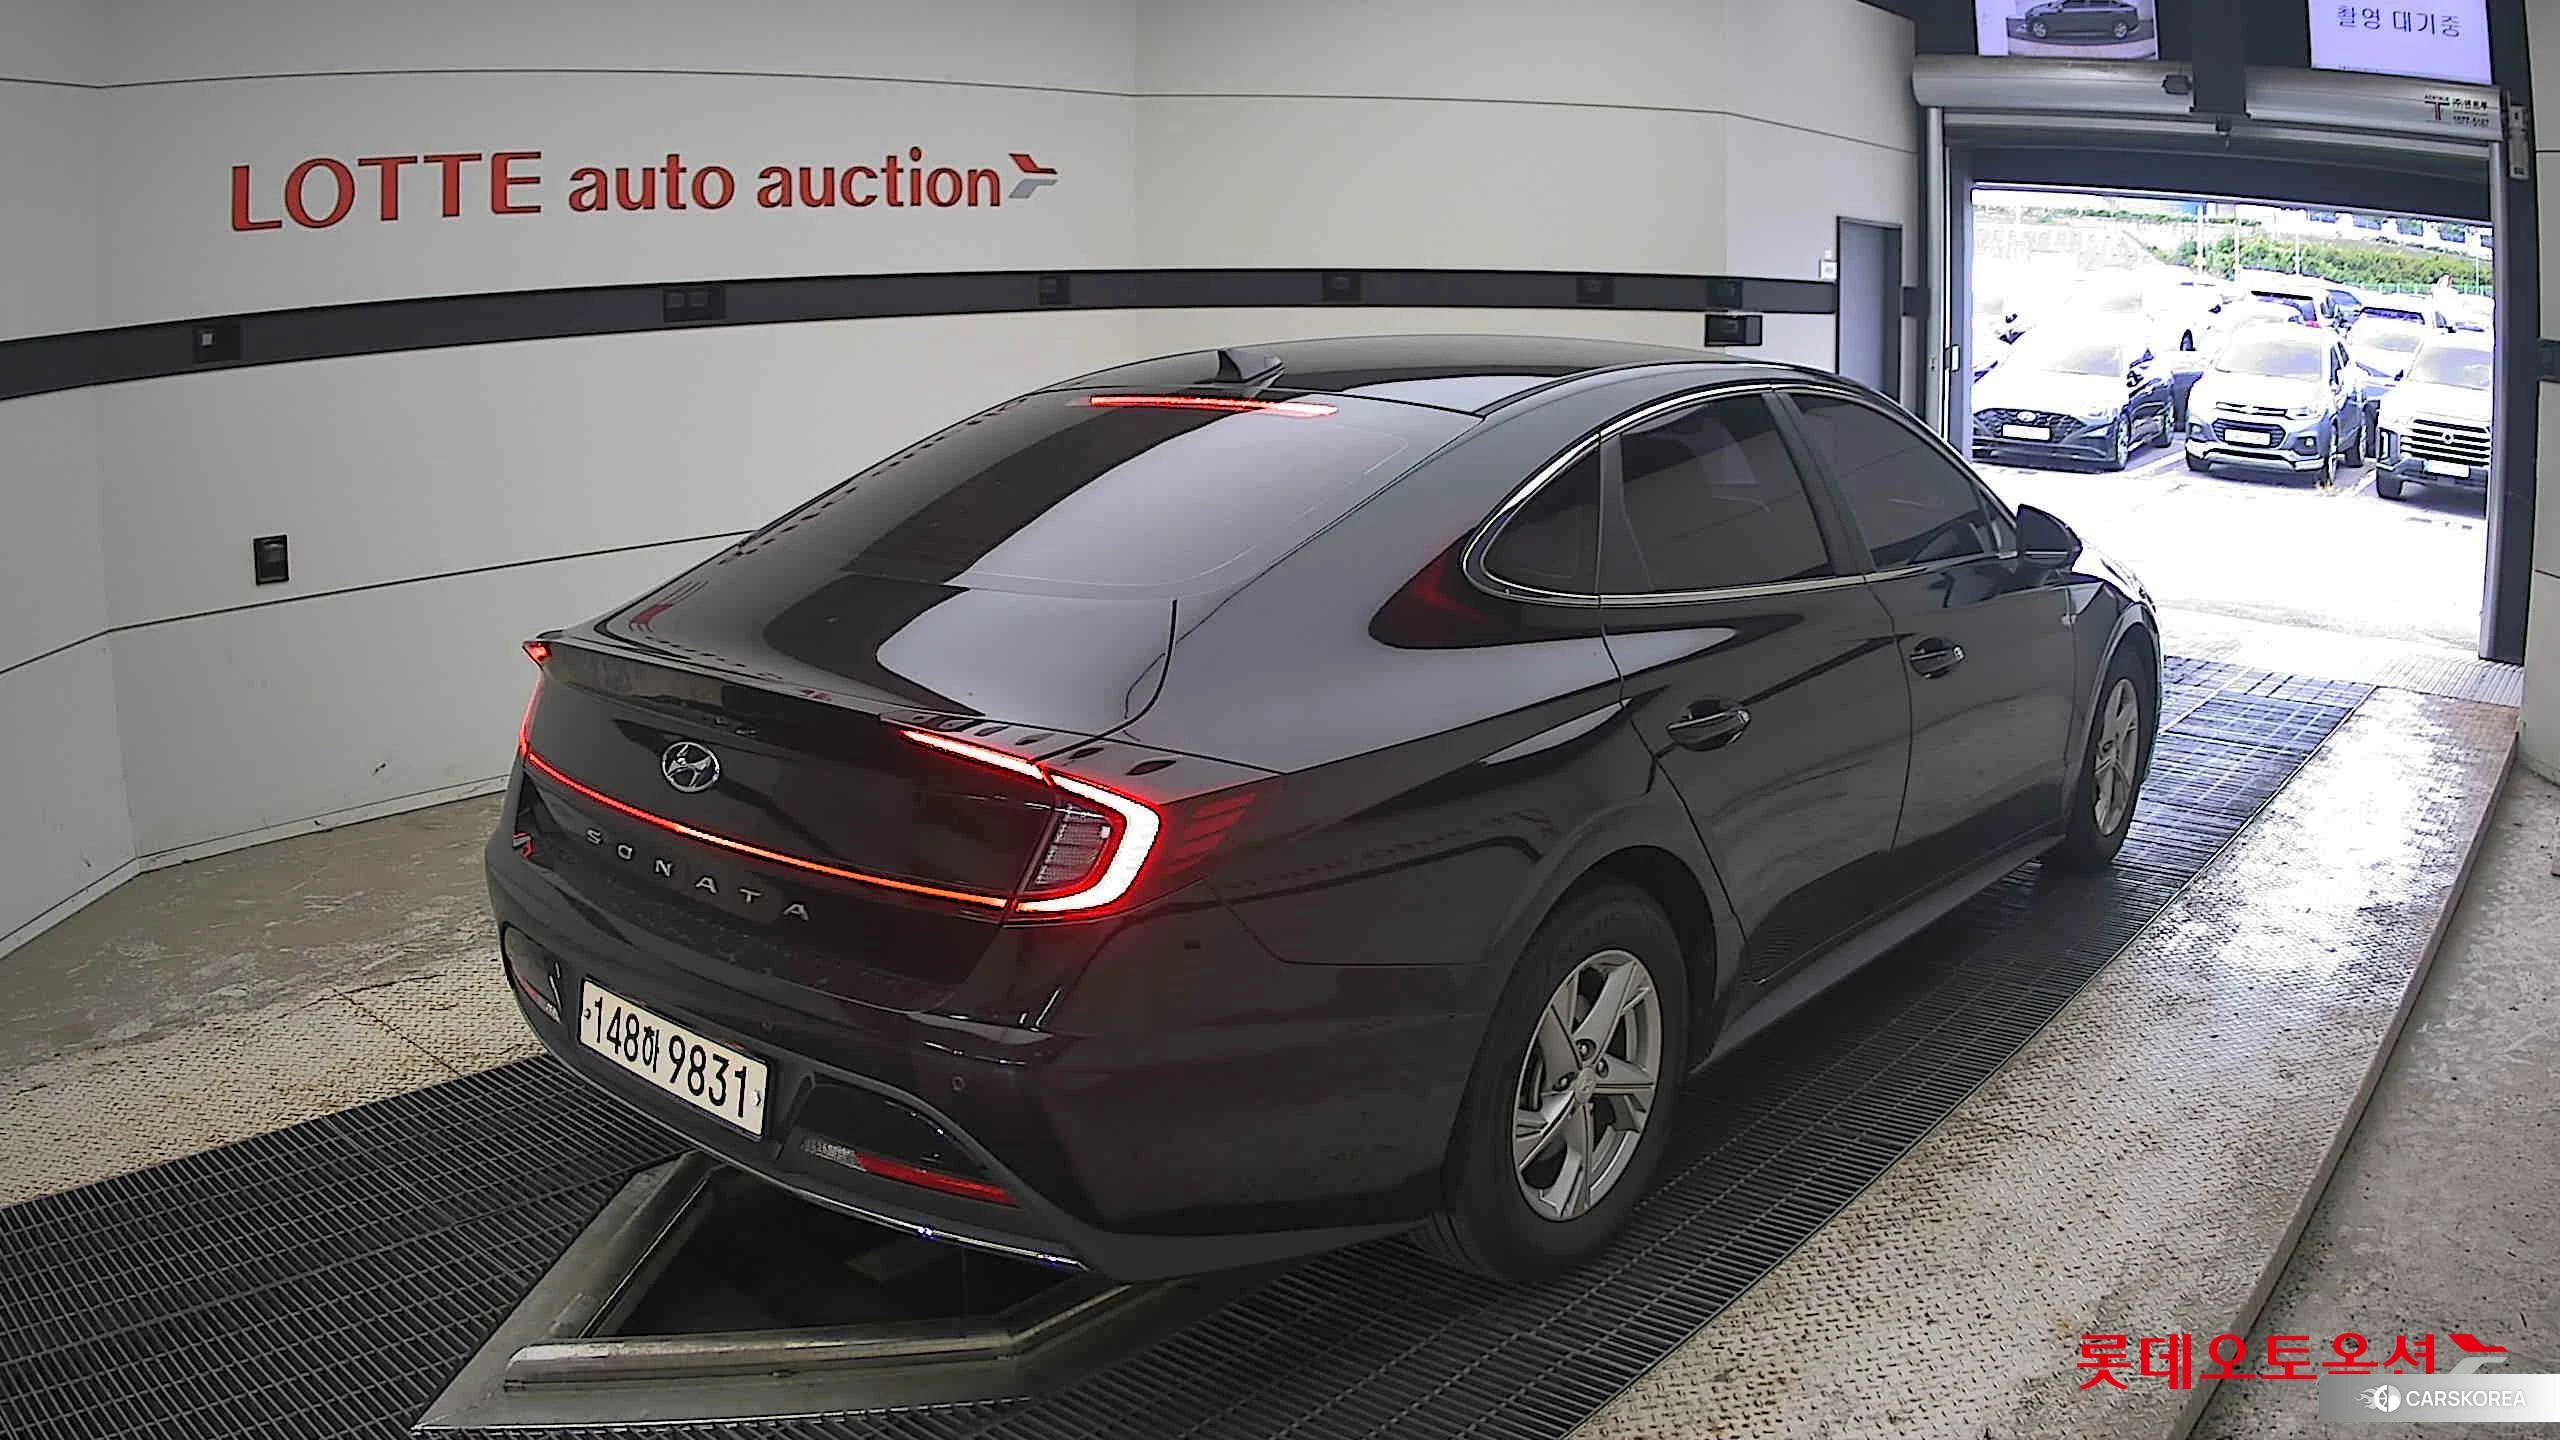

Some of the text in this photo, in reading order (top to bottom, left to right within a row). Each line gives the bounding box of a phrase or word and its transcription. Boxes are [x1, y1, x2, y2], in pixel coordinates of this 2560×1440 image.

[2338, 5, 2461, 38] 촬영 대기중
[232, 147, 1001, 231] LOTTE auto auction
[586, 828, 810, 921] SONATA
